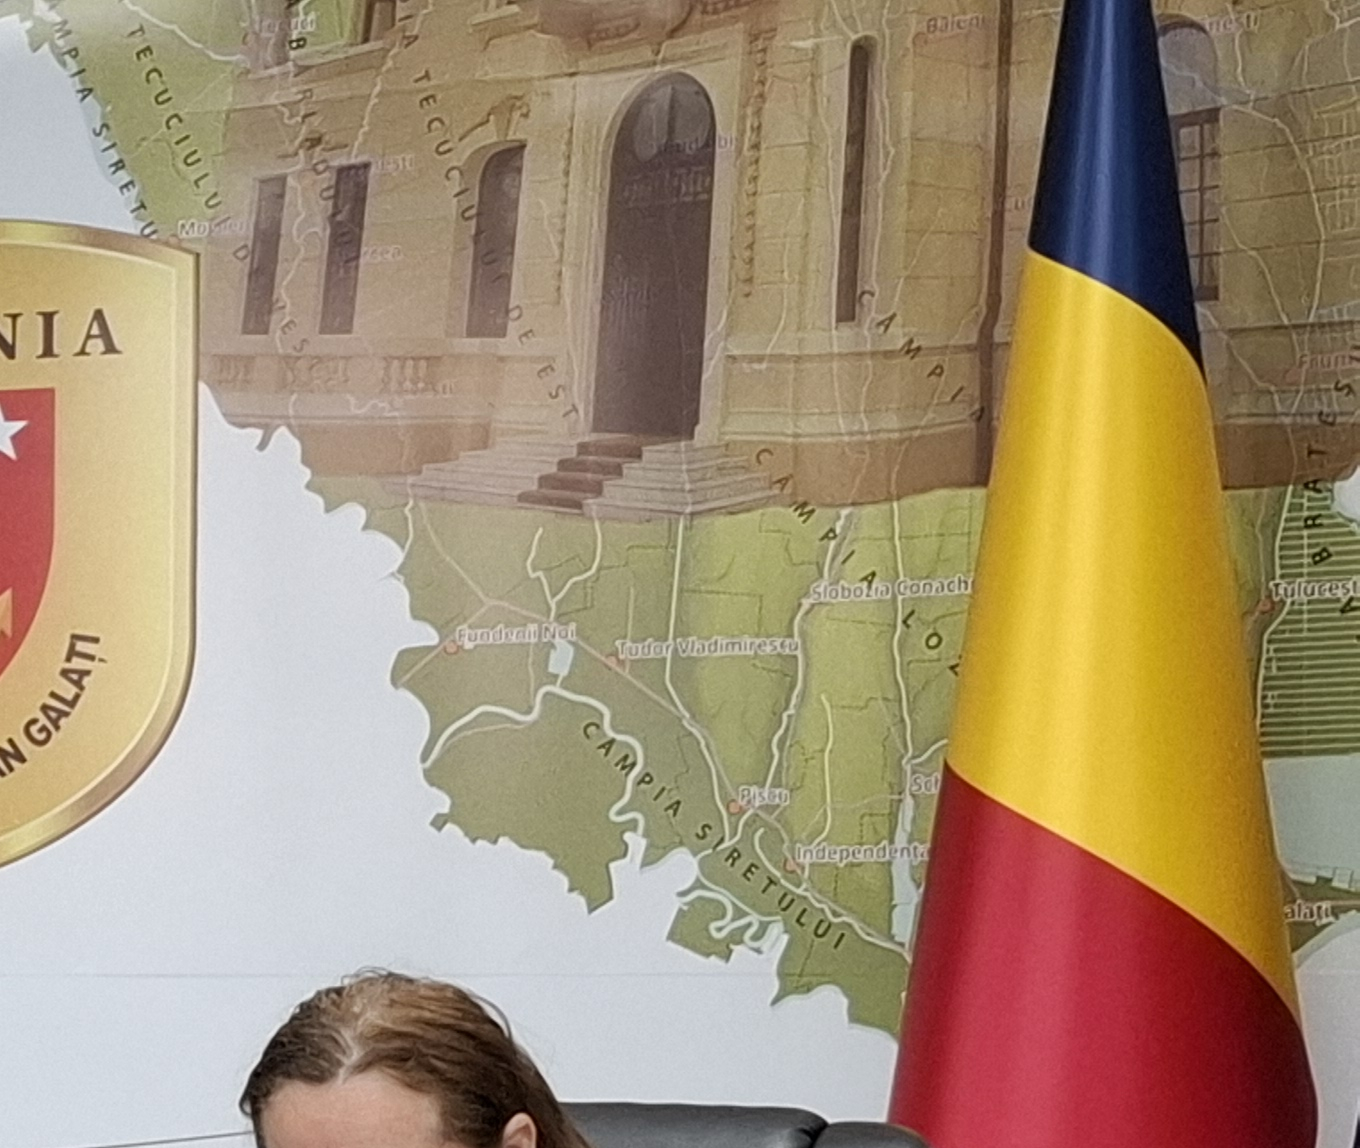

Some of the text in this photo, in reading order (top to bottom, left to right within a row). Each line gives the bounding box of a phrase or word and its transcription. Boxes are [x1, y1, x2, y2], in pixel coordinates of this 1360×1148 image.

[91, 122, 158, 240] SIRETU
[809, 581, 891, 602] Slobozia
[542, 621, 577, 641] Noi
[617, 637, 800, 658] Tudor Vladimirescu
[22, 632, 109, 749] GALAȚI
[695, 822, 847, 950] SIRETULUI
[1283, 901, 1331, 925] alați
